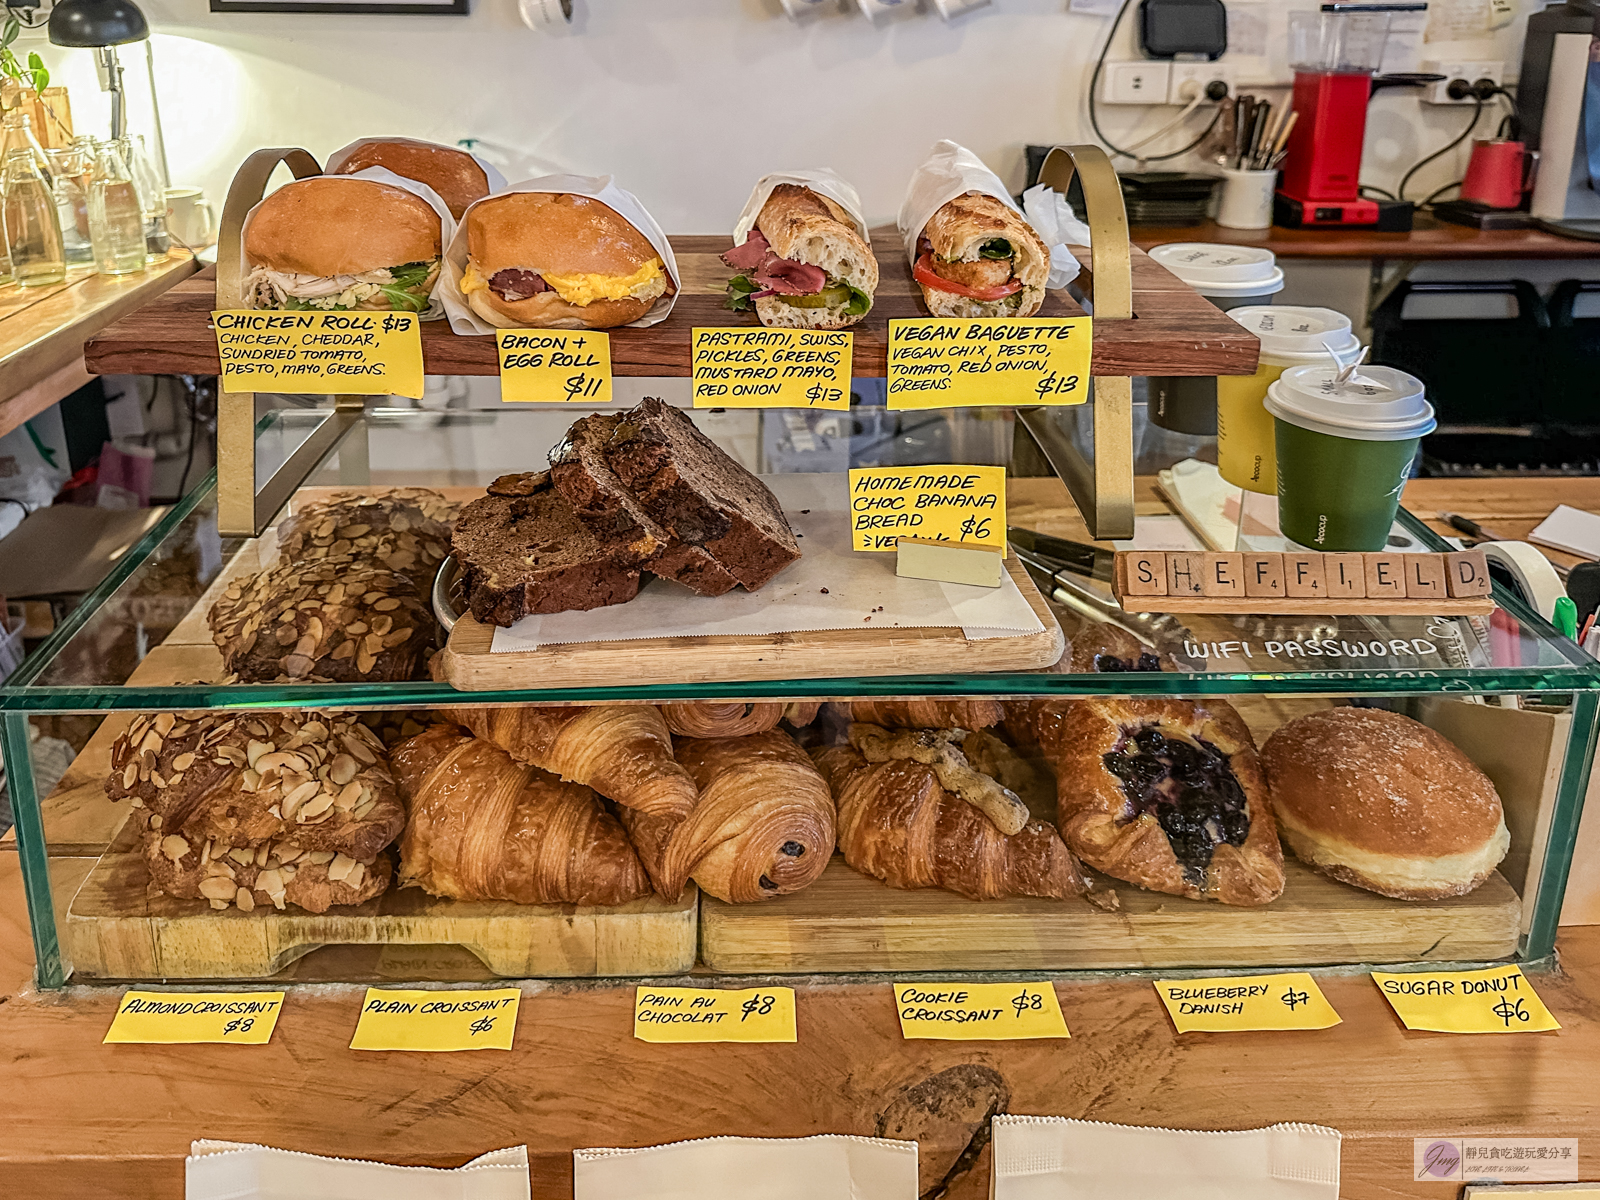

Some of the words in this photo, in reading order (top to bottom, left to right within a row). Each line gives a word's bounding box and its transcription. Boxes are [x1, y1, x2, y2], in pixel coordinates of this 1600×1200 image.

[216, 314, 315, 331] CHICKEN
[320, 315, 374, 331] ROLL
[381, 313, 412, 335] $13
[894, 325, 960, 341] VEGAN
[964, 324, 1076, 342] BAGUETTE
[220, 333, 298, 349] CHICKEN,
[301, 333, 380, 348] CHEDDAR,
[501, 334, 568, 351] BACON
[572, 336, 587, 350] +
[696, 331, 796, 350] PASTRAMI,
[799, 333, 849, 348] SWISS,
[220, 347, 297, 360] SUNDRIED
[300, 349, 367, 363] TOMATO,
[503, 353, 544, 370] EGG
[548, 352, 601, 368] ROLL
[694, 348, 768, 365] PICKLES,
[772, 349, 841, 367] GREENS,
[892, 346, 946, 361] VEGAN
[948, 345, 992, 363] CHIX,
[997, 344, 1051, 358] PESTO,
[225, 362, 279, 378] PESTO,
[281, 363, 325, 378] MAYO,
[326, 362, 386, 376] GREENS.
[695, 366, 778, 380] MUSTARD
[781, 365, 837, 382] MAYO,
[890, 363, 953, 377] TOMATO,
[995, 359, 1048, 375] ONION,
[563, 372, 603, 402] $11
[696, 383, 728, 397] RED
[732, 383, 782, 396] ONION
[805, 381, 843, 406] $13
[889, 377, 952, 394] GREENS.
[1034, 370, 1079, 400] $13
[854, 474, 981, 493] HOMEMADE
[853, 496, 906, 512] CHOC
[914, 493, 997, 510] BANANA
[855, 513, 923, 531] BREAD
[960, 514, 992, 543] $6
[1137, 558, 1476, 591] SHEFFIELD
[1184, 640, 1253, 659] WIFI
[1265, 637, 1438, 658] PASSWORD
[1383, 980, 1455, 996] SUGAR
[1460, 973, 1522, 995] DONUT
[364, 999, 417, 1014] PLAIN
[420, 998, 516, 1014] CROISSANT
[900, 988, 969, 1004] COOKIE
[1011, 988, 1042, 1019] $8
[1167, 984, 1269, 1001] BLUEBERRY
[1280, 986, 1310, 1012] $7
[637, 1009, 728, 1024] CHOCOLAT
[639, 994, 684, 1007] PAIN
[689, 996, 717, 1008] AU
[741, 993, 776, 1023] $8
[901, 1007, 1004, 1024] CROISSANT
[1179, 1001, 1244, 1015] DANISH
[1492, 995, 1530, 1027] $6
[223, 1017, 255, 1036] $8
[470, 1015, 497, 1036] $6
